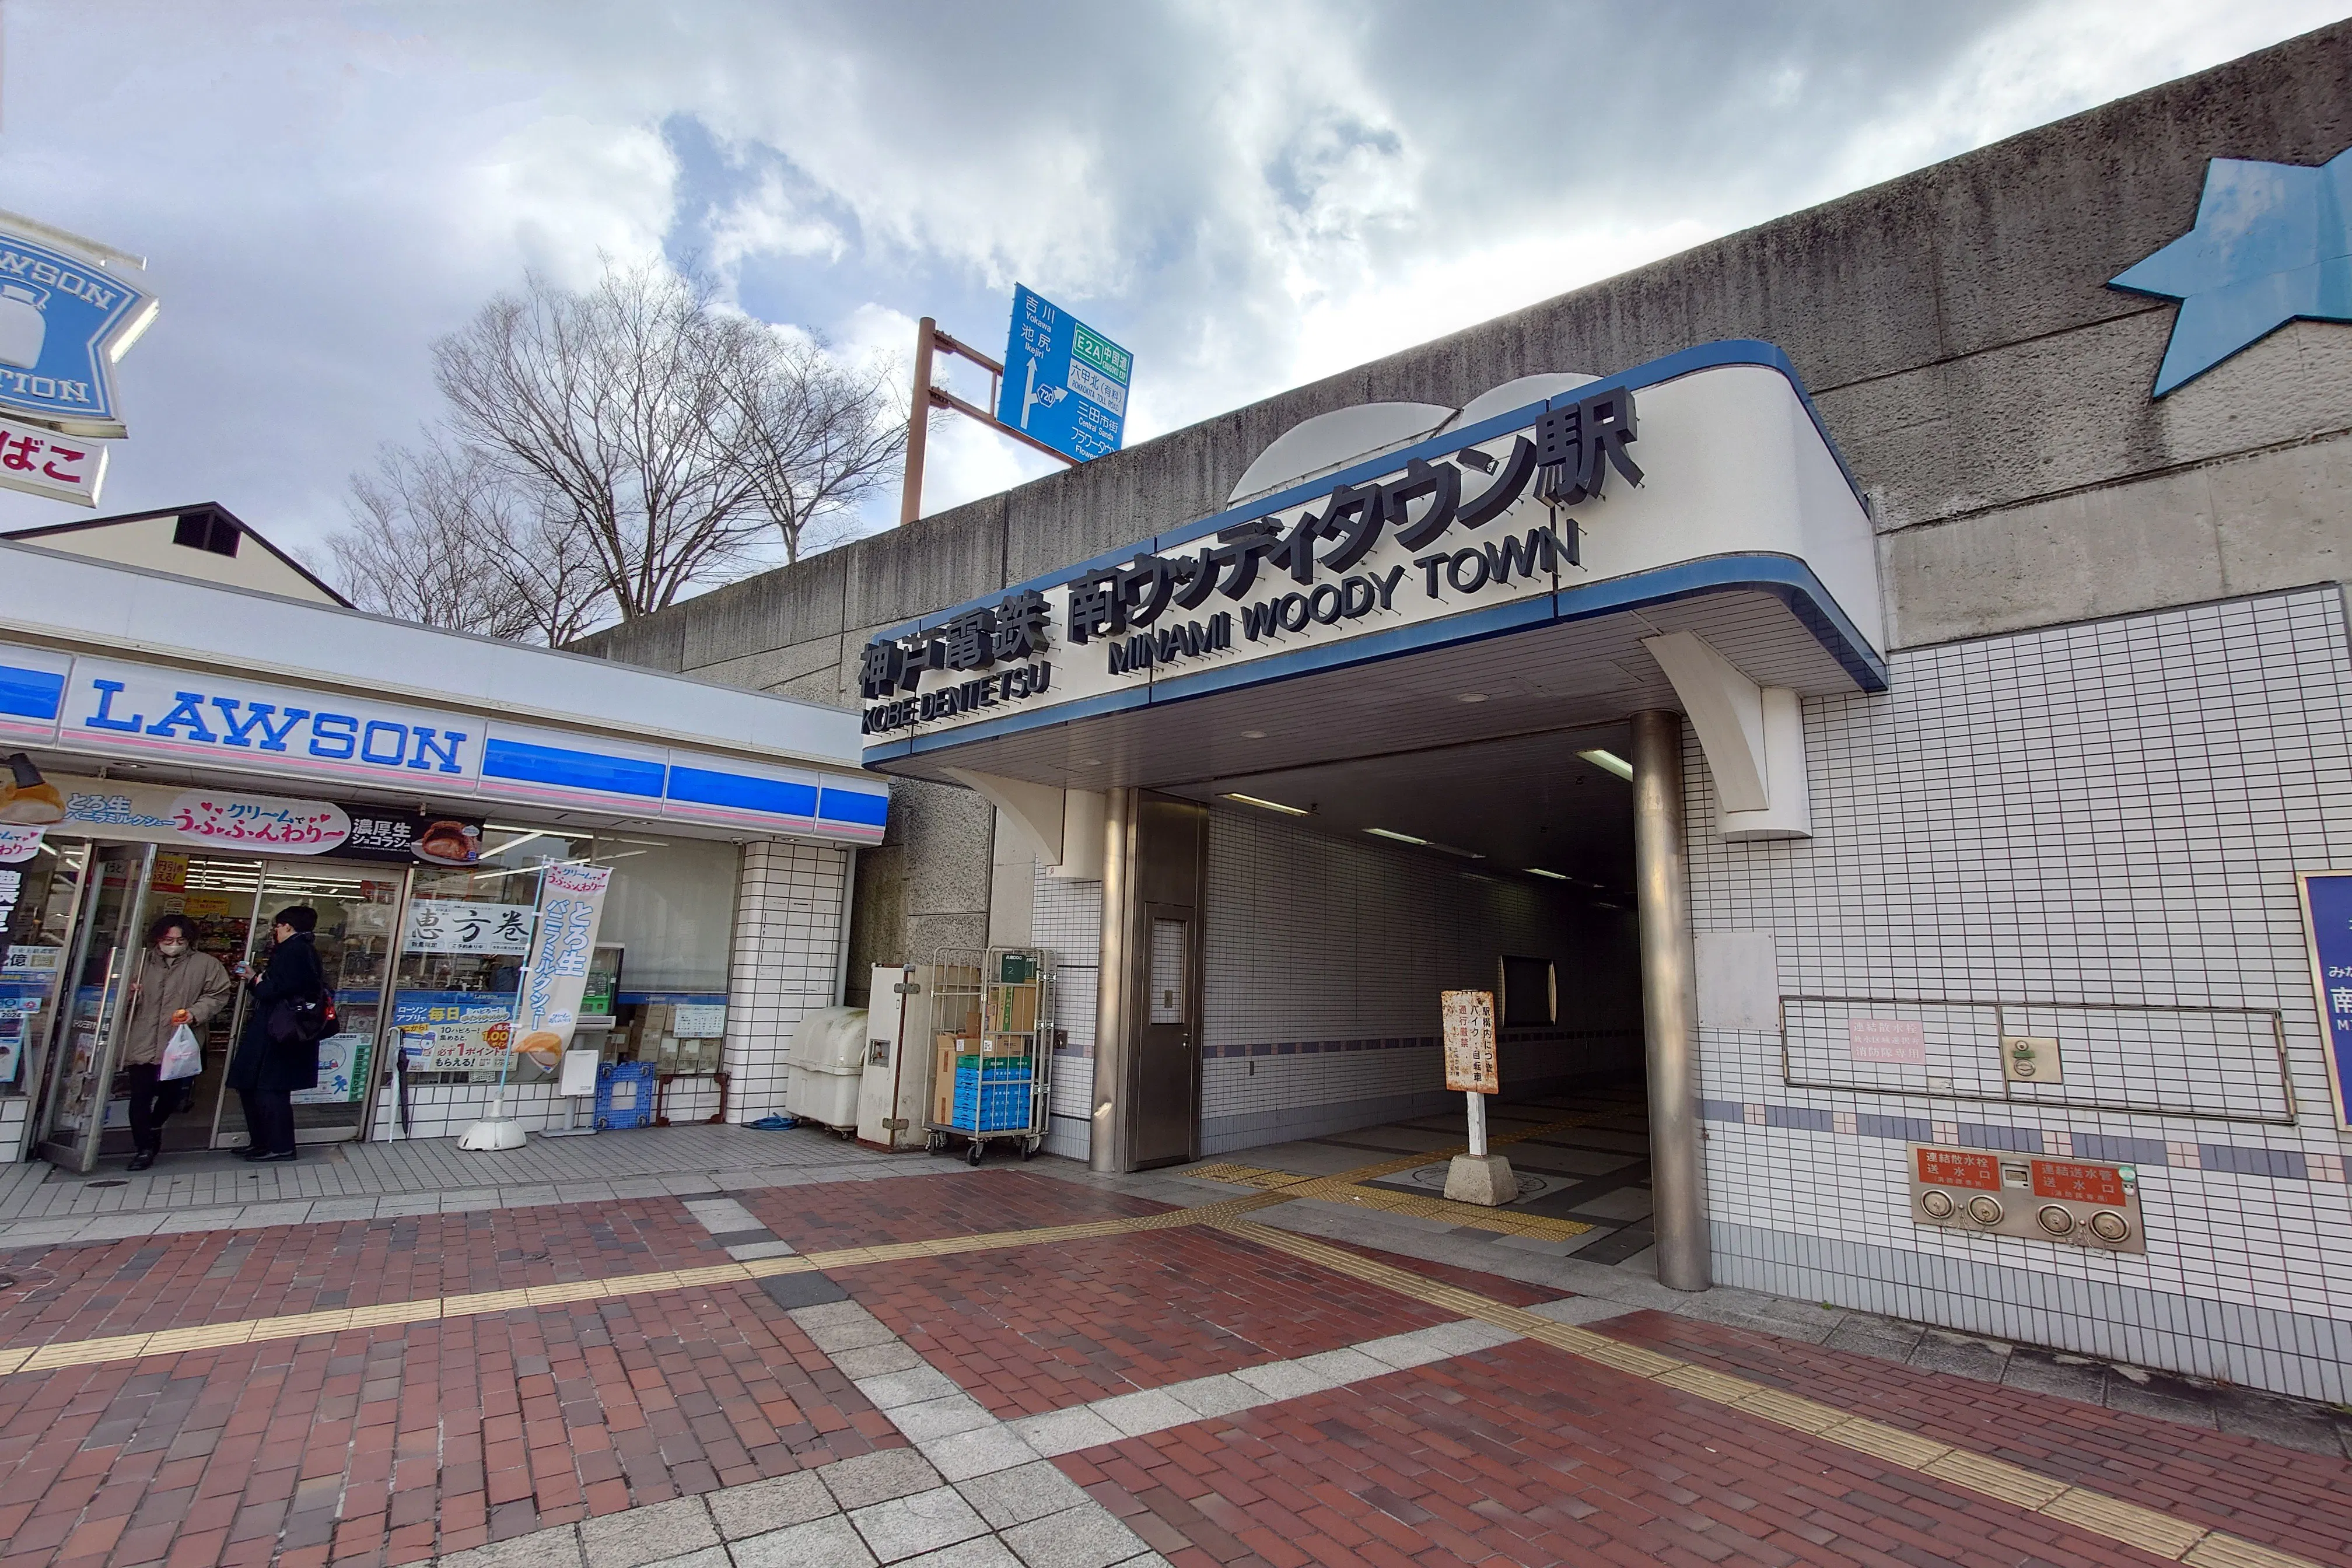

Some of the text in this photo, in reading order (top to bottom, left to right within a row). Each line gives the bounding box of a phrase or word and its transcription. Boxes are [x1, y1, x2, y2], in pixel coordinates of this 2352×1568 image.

[1026, 296, 1055, 324] 吉川
[1027, 310, 1051, 332] Yokawa
[1021, 323, 1051, 352] 池尻
[1025, 342, 1044, 359] Ikejiri
[1077, 335, 1101, 360] E2A
[1102, 360, 1118, 377] CHUGOKU
[1104, 346, 1128, 372] 中国道
[1040, 388, 1053, 402] 720
[1070, 364, 1122, 403] 六甲北(有料)
[1072, 380, 1119, 412] ROKKOKITA TOLL ROAD
[1077, 400, 1118, 433] 三田市街
[1079, 416, 1114, 442] Central Sanda
[859, 385, 1645, 699] 神戸電鉄 南ウッディタウン駅
[861, 519, 1580, 734] KOBE DENTETSU MINAMI WOODY TOWN
[85, 679, 467, 774] LAWSON
[66, 792, 132, 814] とろ生
[64, 811, 176, 827] バニラミルクシュー
[352, 818, 411, 838] 濃厚生
[412, 908, 530, 943] 恵方巻
[555, 902, 593, 977] とろ生
[531, 899, 570, 1031] バニラミルクシュー
[2330, 986, 2352, 1014] 南
[397, 1014, 426, 1022] アプリで
[428, 1007, 460, 1022] 毎日
[1458, 1005, 1468, 1048] 通行厳禁
[1482, 1006, 1493, 1072] 駅構内につき
[436, 1058, 475, 1067] もらえる!
[1926, 1152, 1989, 1168] 連結散水栓
[2042, 1164, 2112, 1182] 連結送水管
